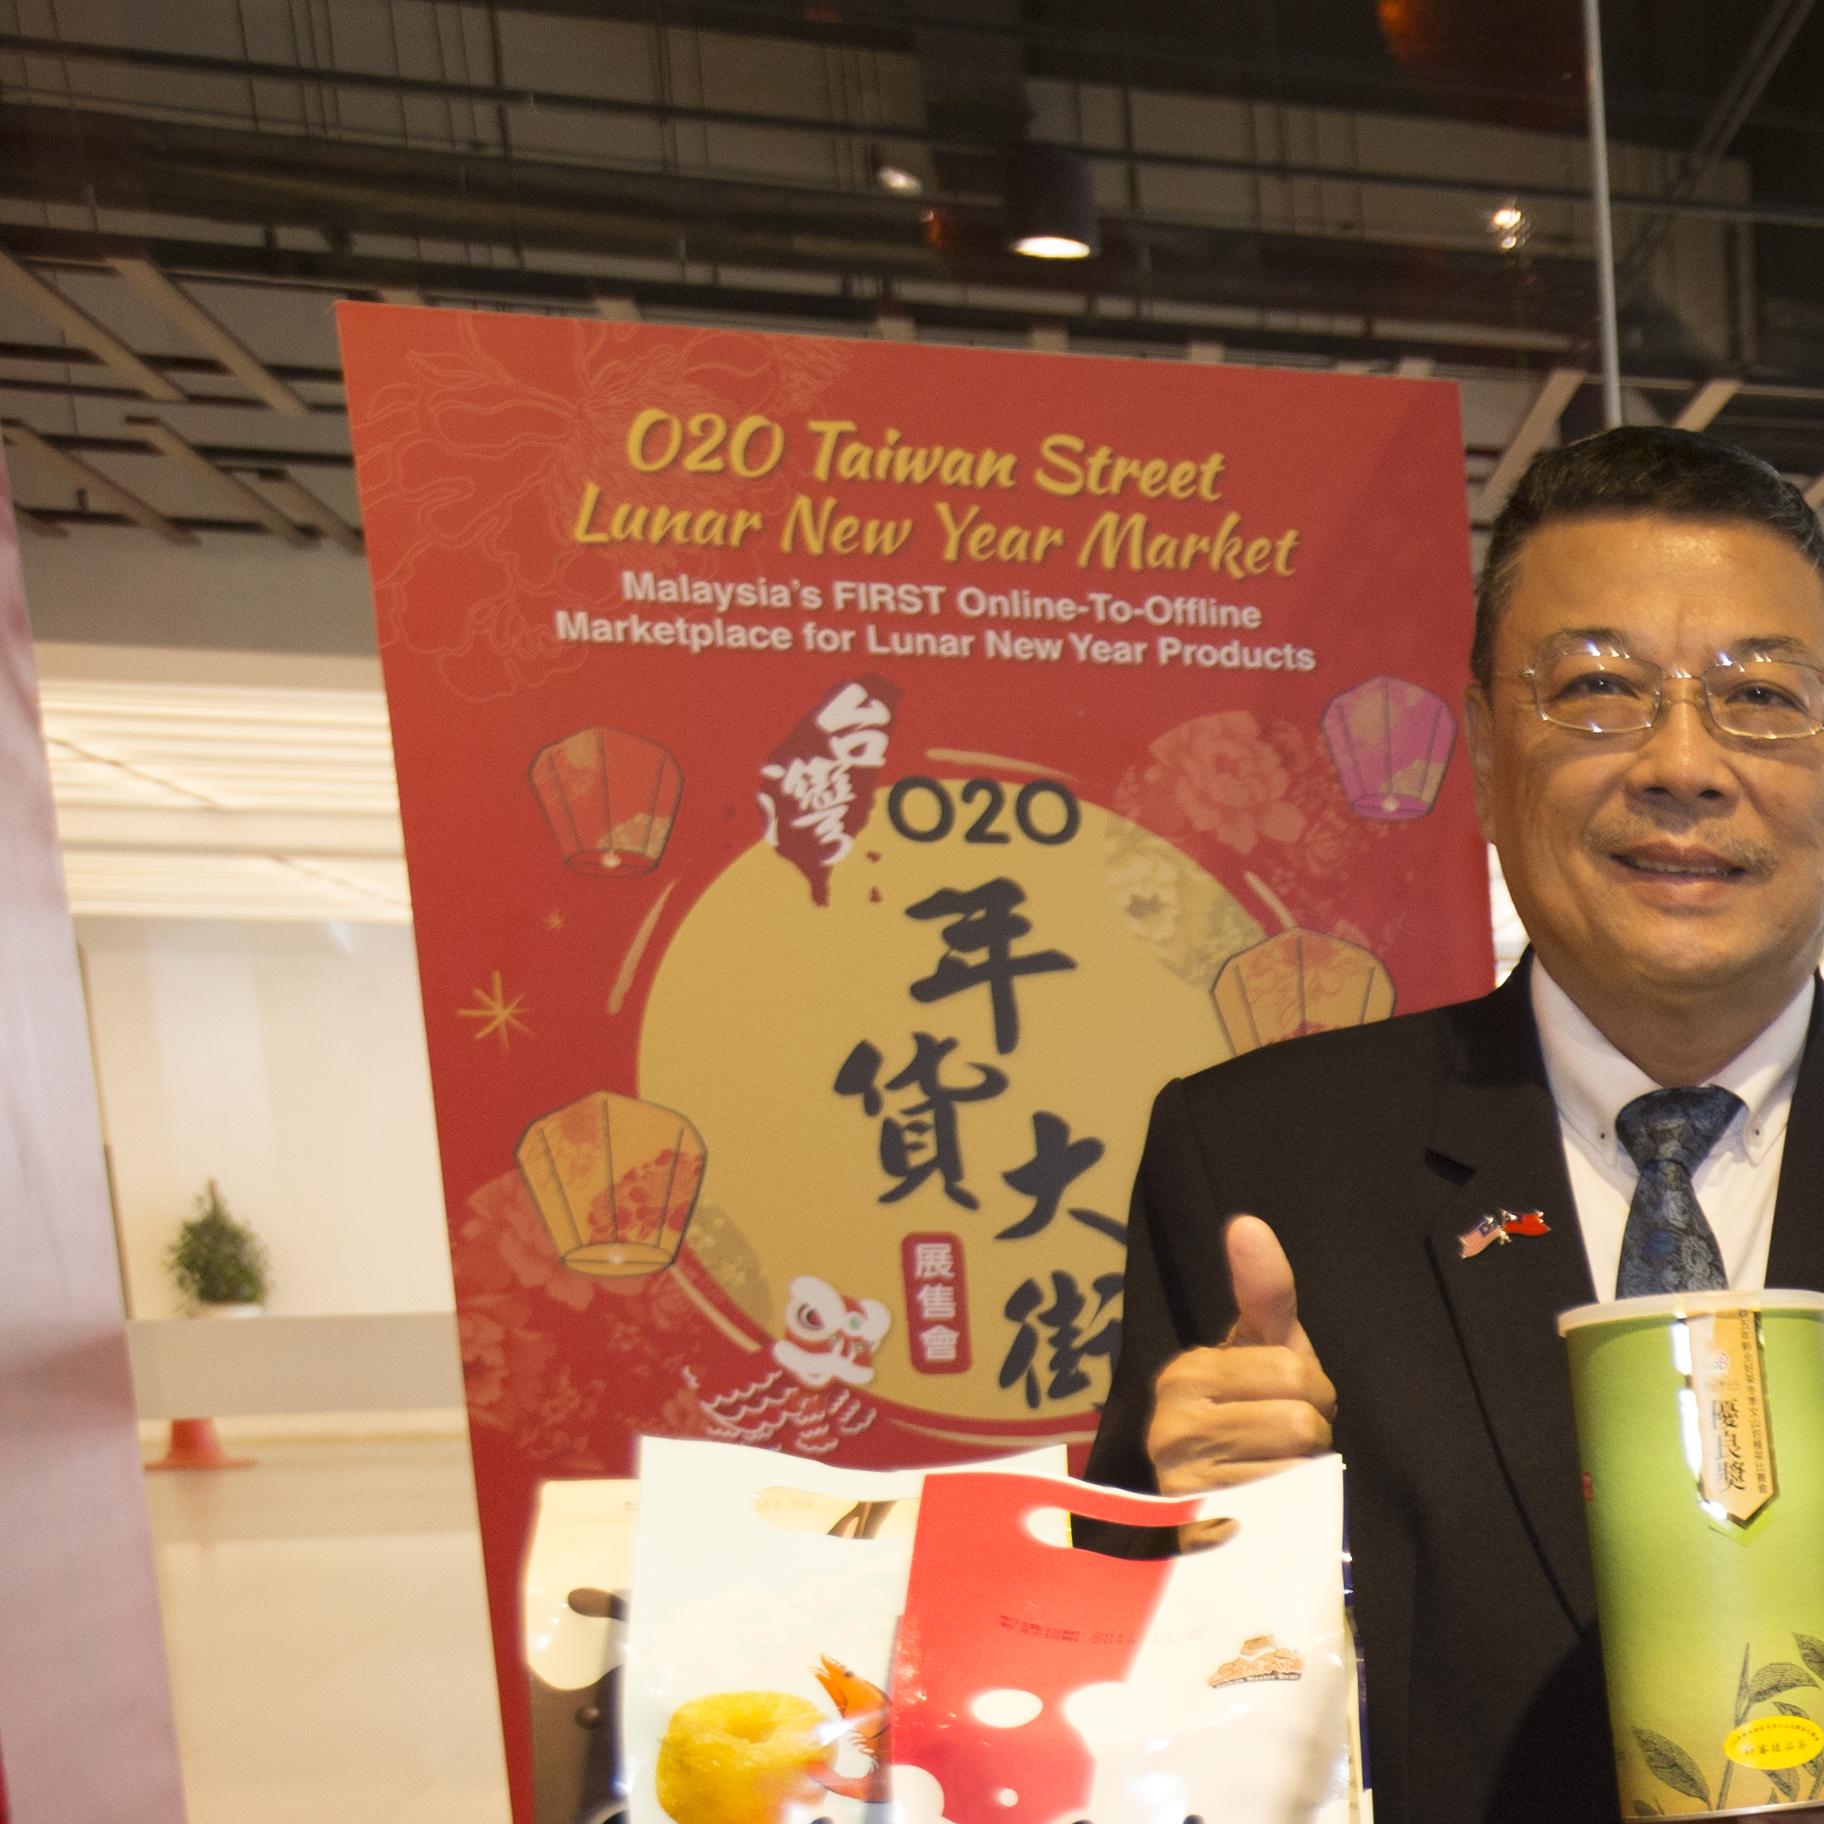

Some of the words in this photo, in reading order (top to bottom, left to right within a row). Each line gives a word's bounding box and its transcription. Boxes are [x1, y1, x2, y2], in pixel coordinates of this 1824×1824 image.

[807, 420, 1018, 490] Taiwan
[1034, 432, 1226, 502] Street
[574, 483, 763, 548] Lunar
[780, 494, 914, 557] New
[934, 502, 1065, 564] Year
[1077, 511, 1300, 580] Market
[555, 610, 794, 653] Marketplace
[803, 622, 856, 652] for
[866, 625, 974, 658] Lunar
[984, 629, 1063, 662] New
[1070, 632, 1149, 666] Year
[1157, 638, 1316, 672] Products
[622, 571, 823, 612] Malaysia's
[834, 581, 946, 616] FIRST
[957, 587, 1263, 629] Online-To-Offline
[912, 1242, 962, 1364] 展售會
